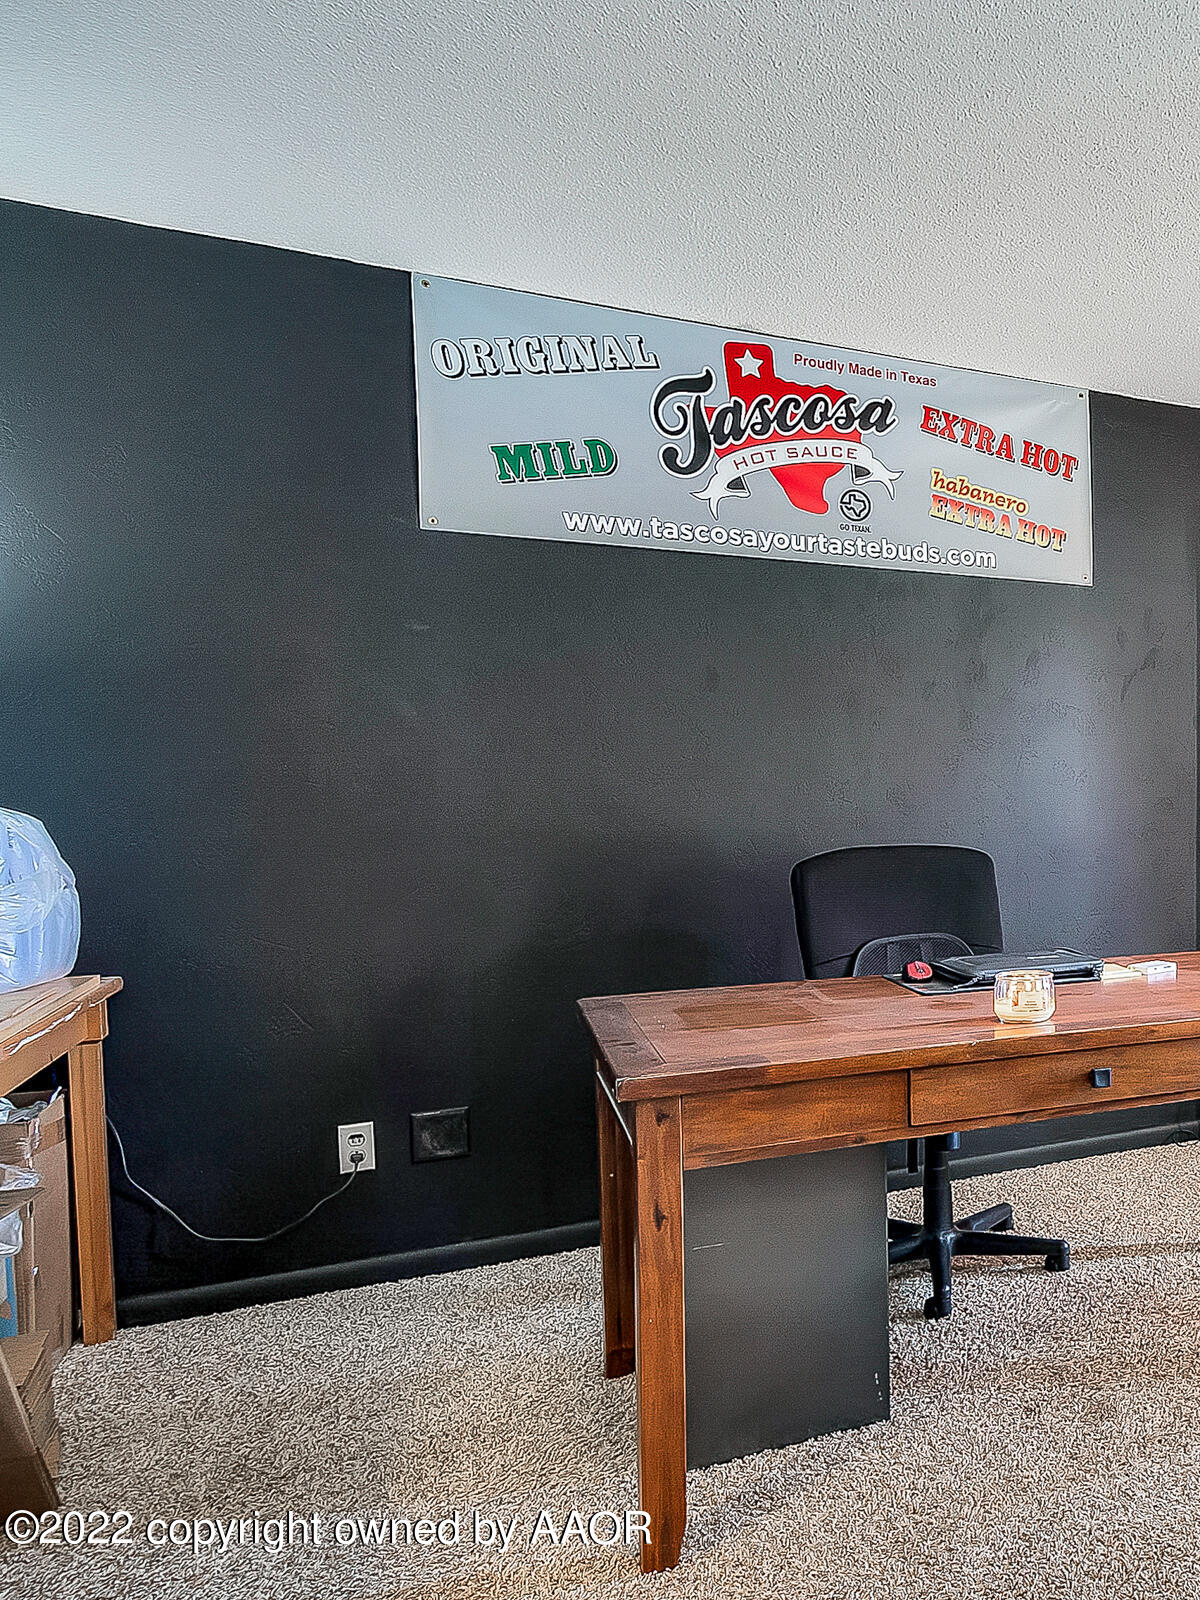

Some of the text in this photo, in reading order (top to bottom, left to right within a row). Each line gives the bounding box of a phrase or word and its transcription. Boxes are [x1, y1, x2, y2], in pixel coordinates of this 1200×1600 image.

[431, 335, 660, 379] ORIGINAL
[794, 353, 937, 387] Proudly Made in Texas
[651, 366, 899, 478] Tascosa
[920, 404, 1078, 482] EXTRA HOT
[488, 438, 618, 484] MILD
[733, 446, 858, 470] HOT SAUCE
[931, 468, 1029, 516] habanero
[562, 511, 997, 569] www.tascosayourtastebuds.com
[840, 523, 850, 533] GO
[929, 494, 1067, 552] EXTRA HOT
